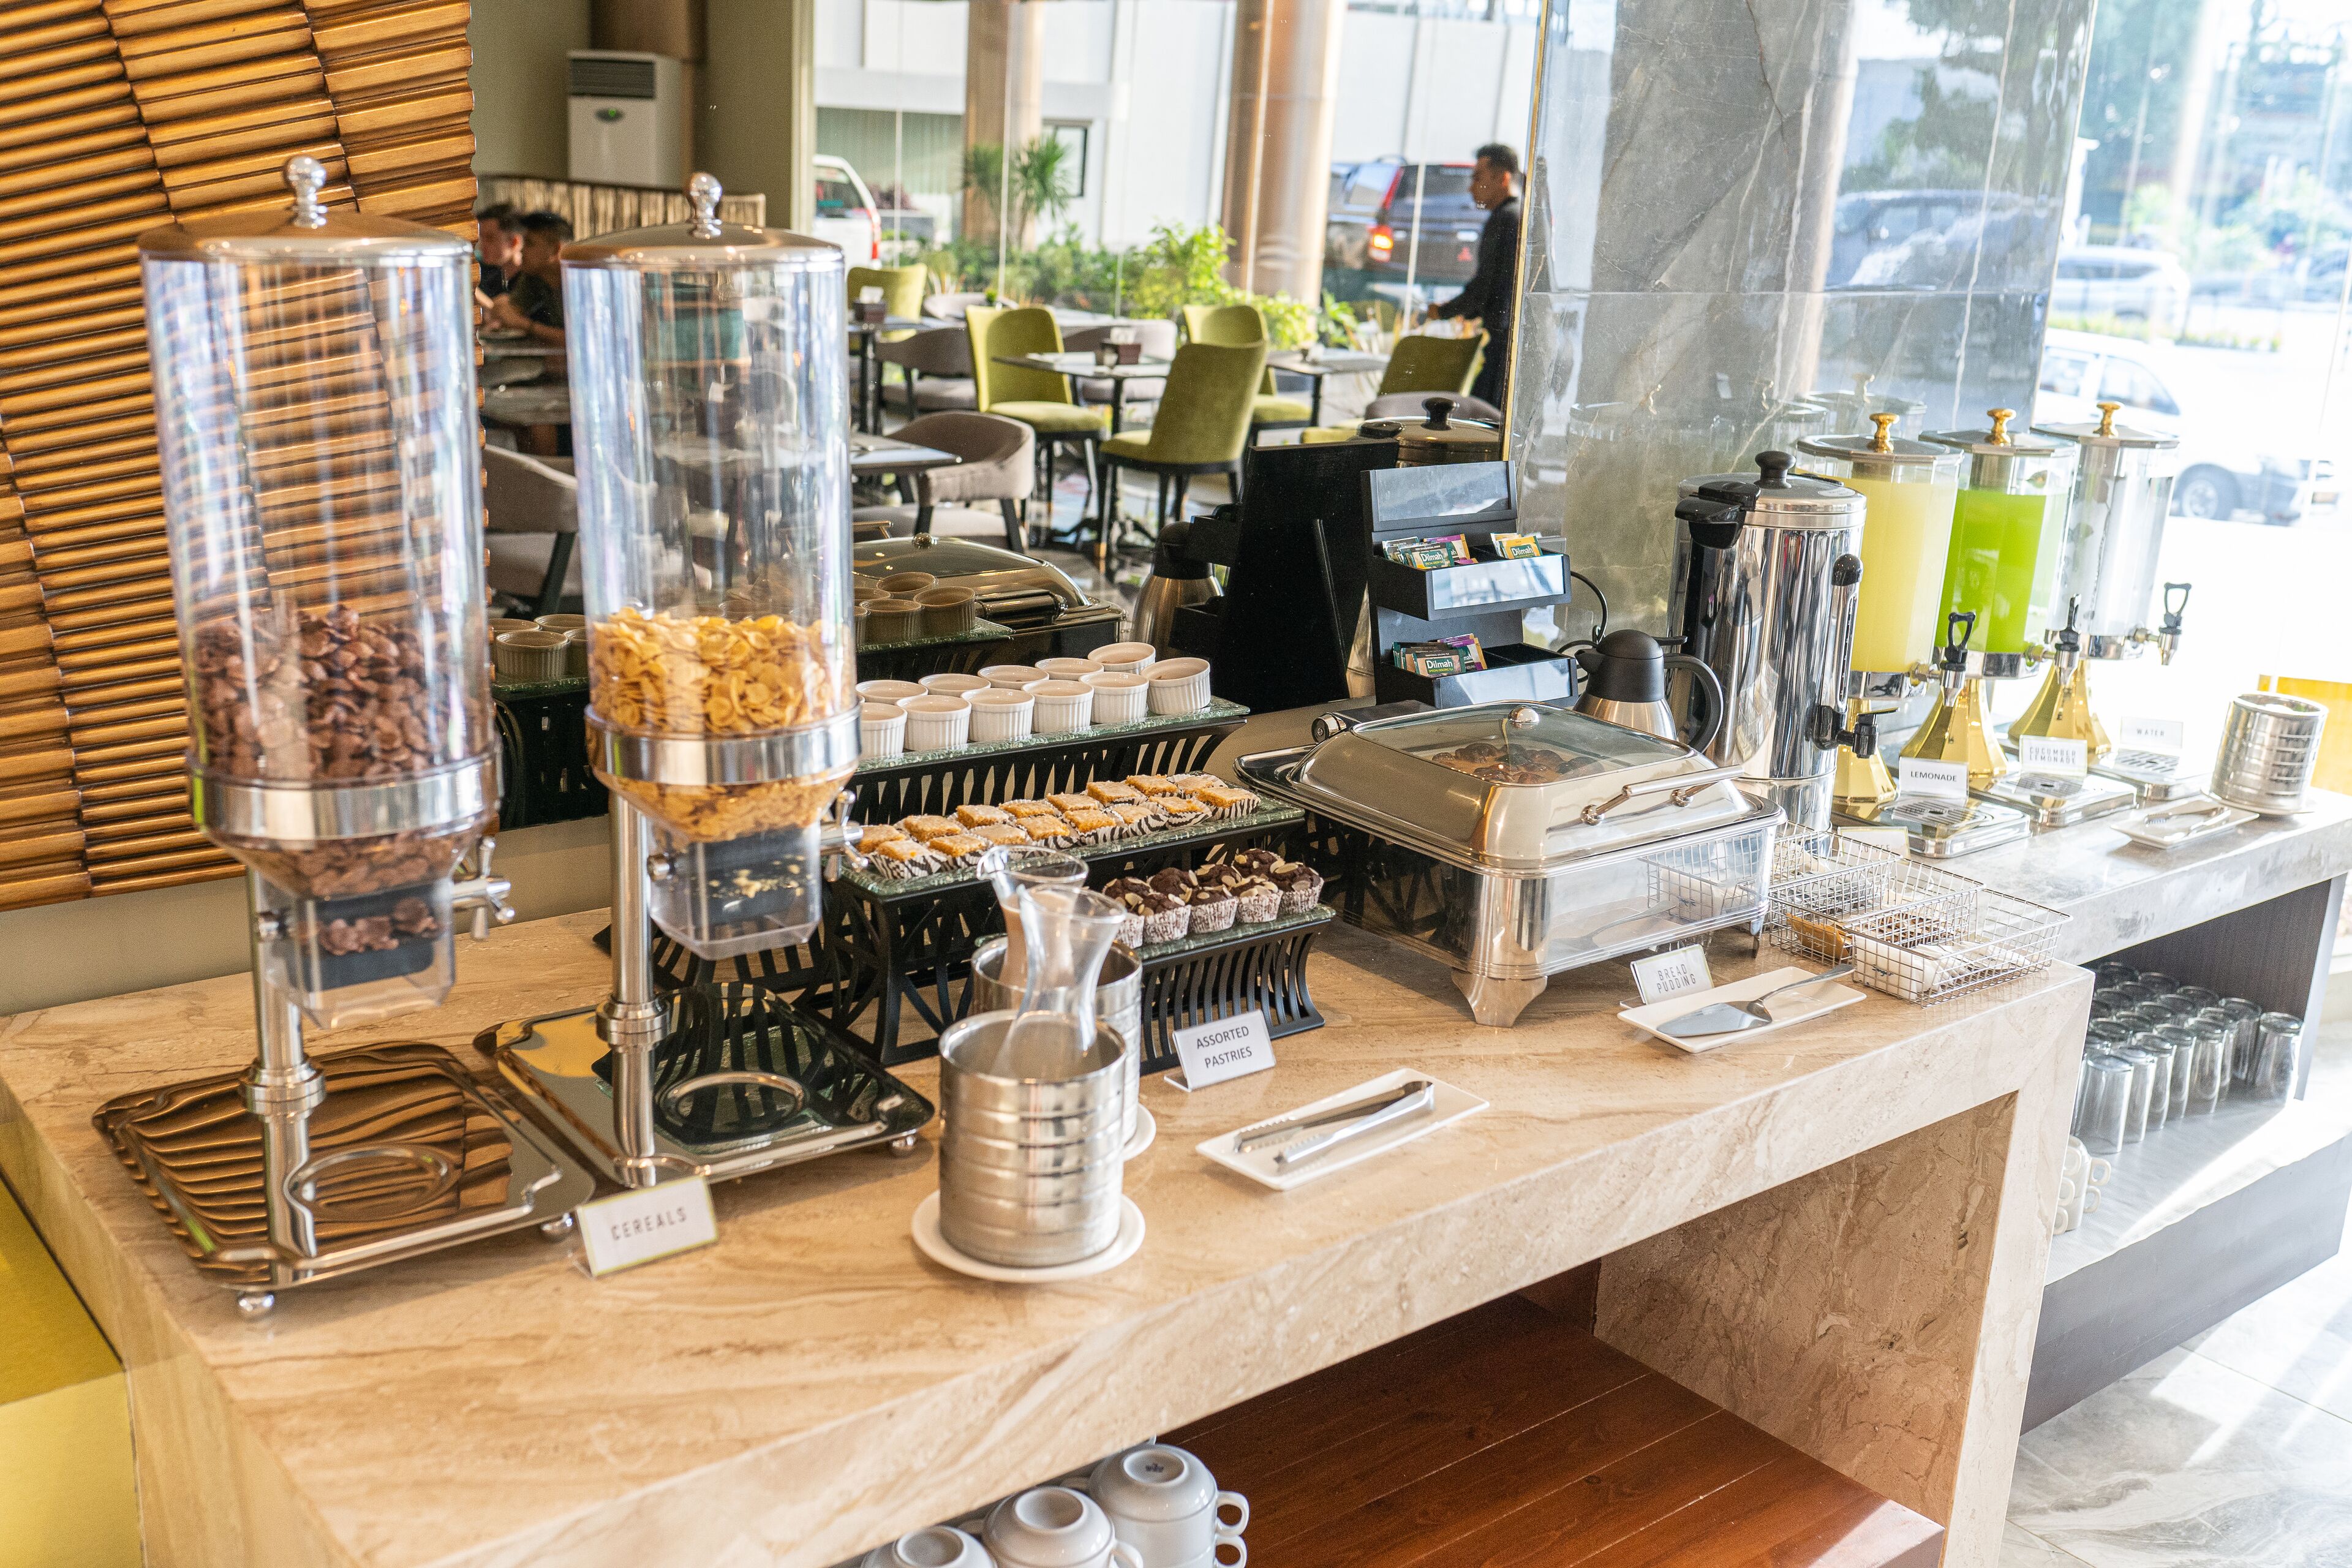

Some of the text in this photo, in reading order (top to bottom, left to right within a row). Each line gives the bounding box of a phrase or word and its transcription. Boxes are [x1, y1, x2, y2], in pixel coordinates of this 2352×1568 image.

[1511, 546, 1534, 556] Dilmah
[1420, 552, 1443, 562] Dilmah
[1426, 659, 1453, 669] Dilmah
[2029, 747, 2076, 756] CUCUMBER
[2029, 755, 2076, 764] LEMONADE
[1910, 771, 1957, 782] LEMONADE
[1657, 963, 1687, 981] BREAD
[1656, 973, 1696, 993] PUDDING
[1196, 1026, 1249, 1049] ASSORTED
[1204, 1046, 1253, 1068] PASTRIES
[610, 1207, 687, 1241] CEREALS
